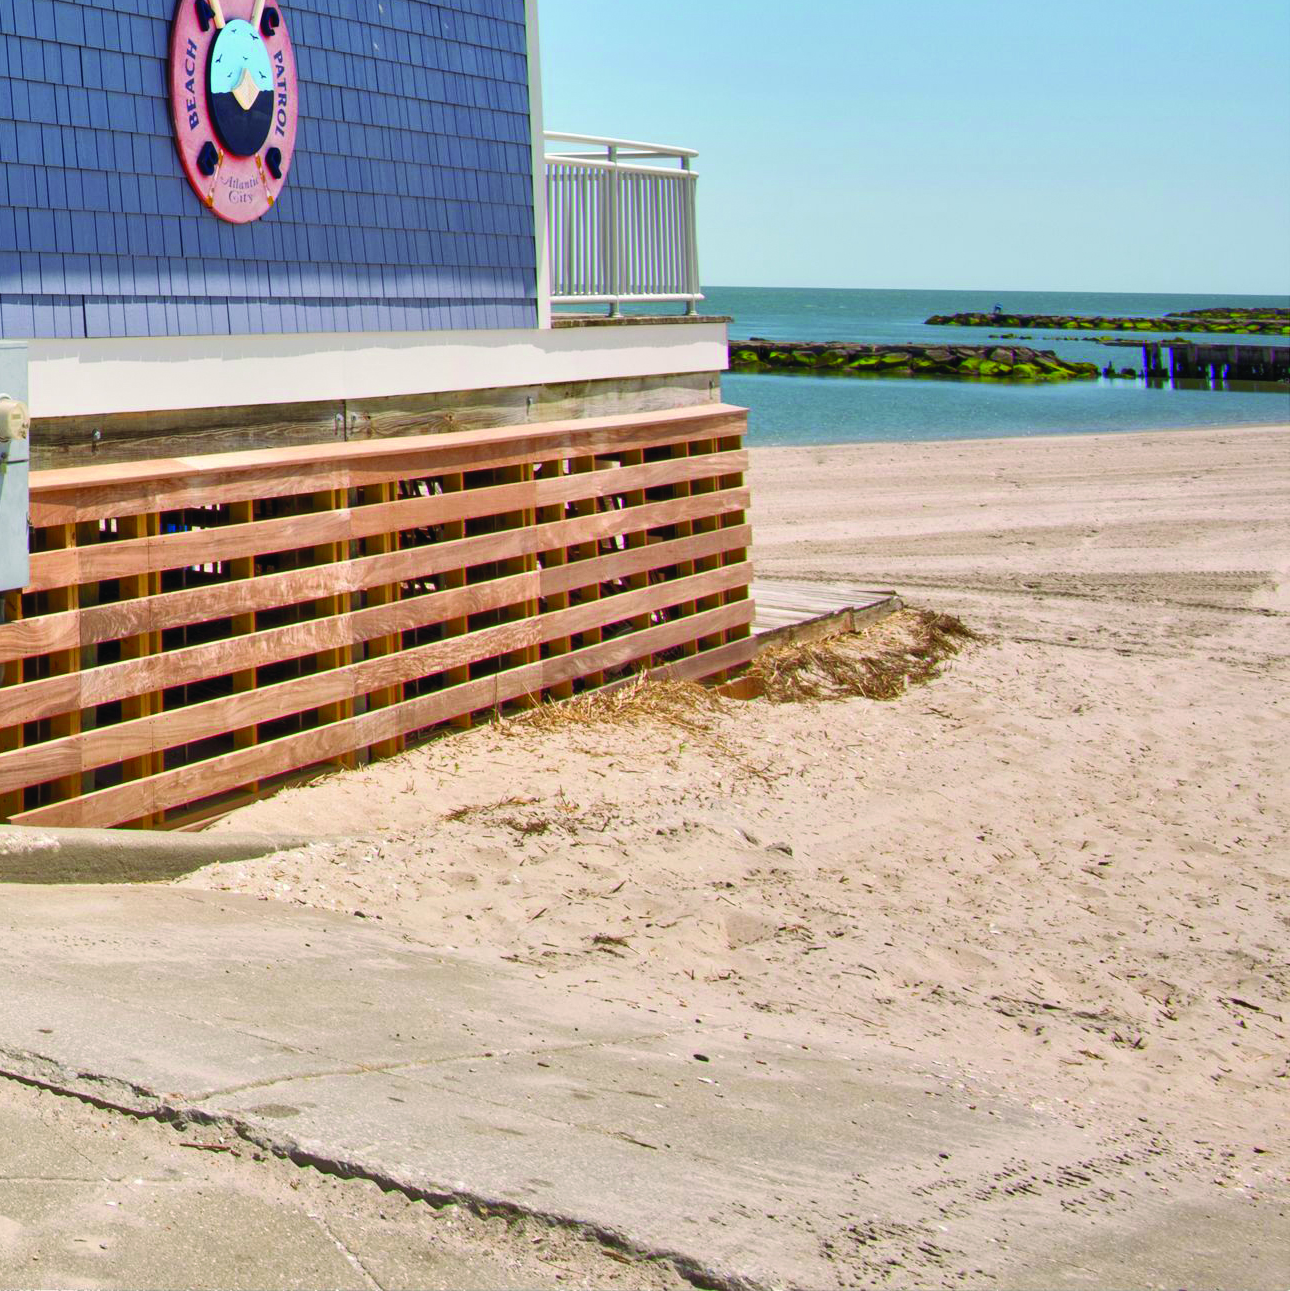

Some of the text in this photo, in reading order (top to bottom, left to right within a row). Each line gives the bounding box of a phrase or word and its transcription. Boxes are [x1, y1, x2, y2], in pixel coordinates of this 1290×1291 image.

[261, 7, 280, 37] C
[185, 38, 288, 138] BEACH PATROL
[221, 175, 259, 190] Atlantic
[228, 189, 254, 204] City
